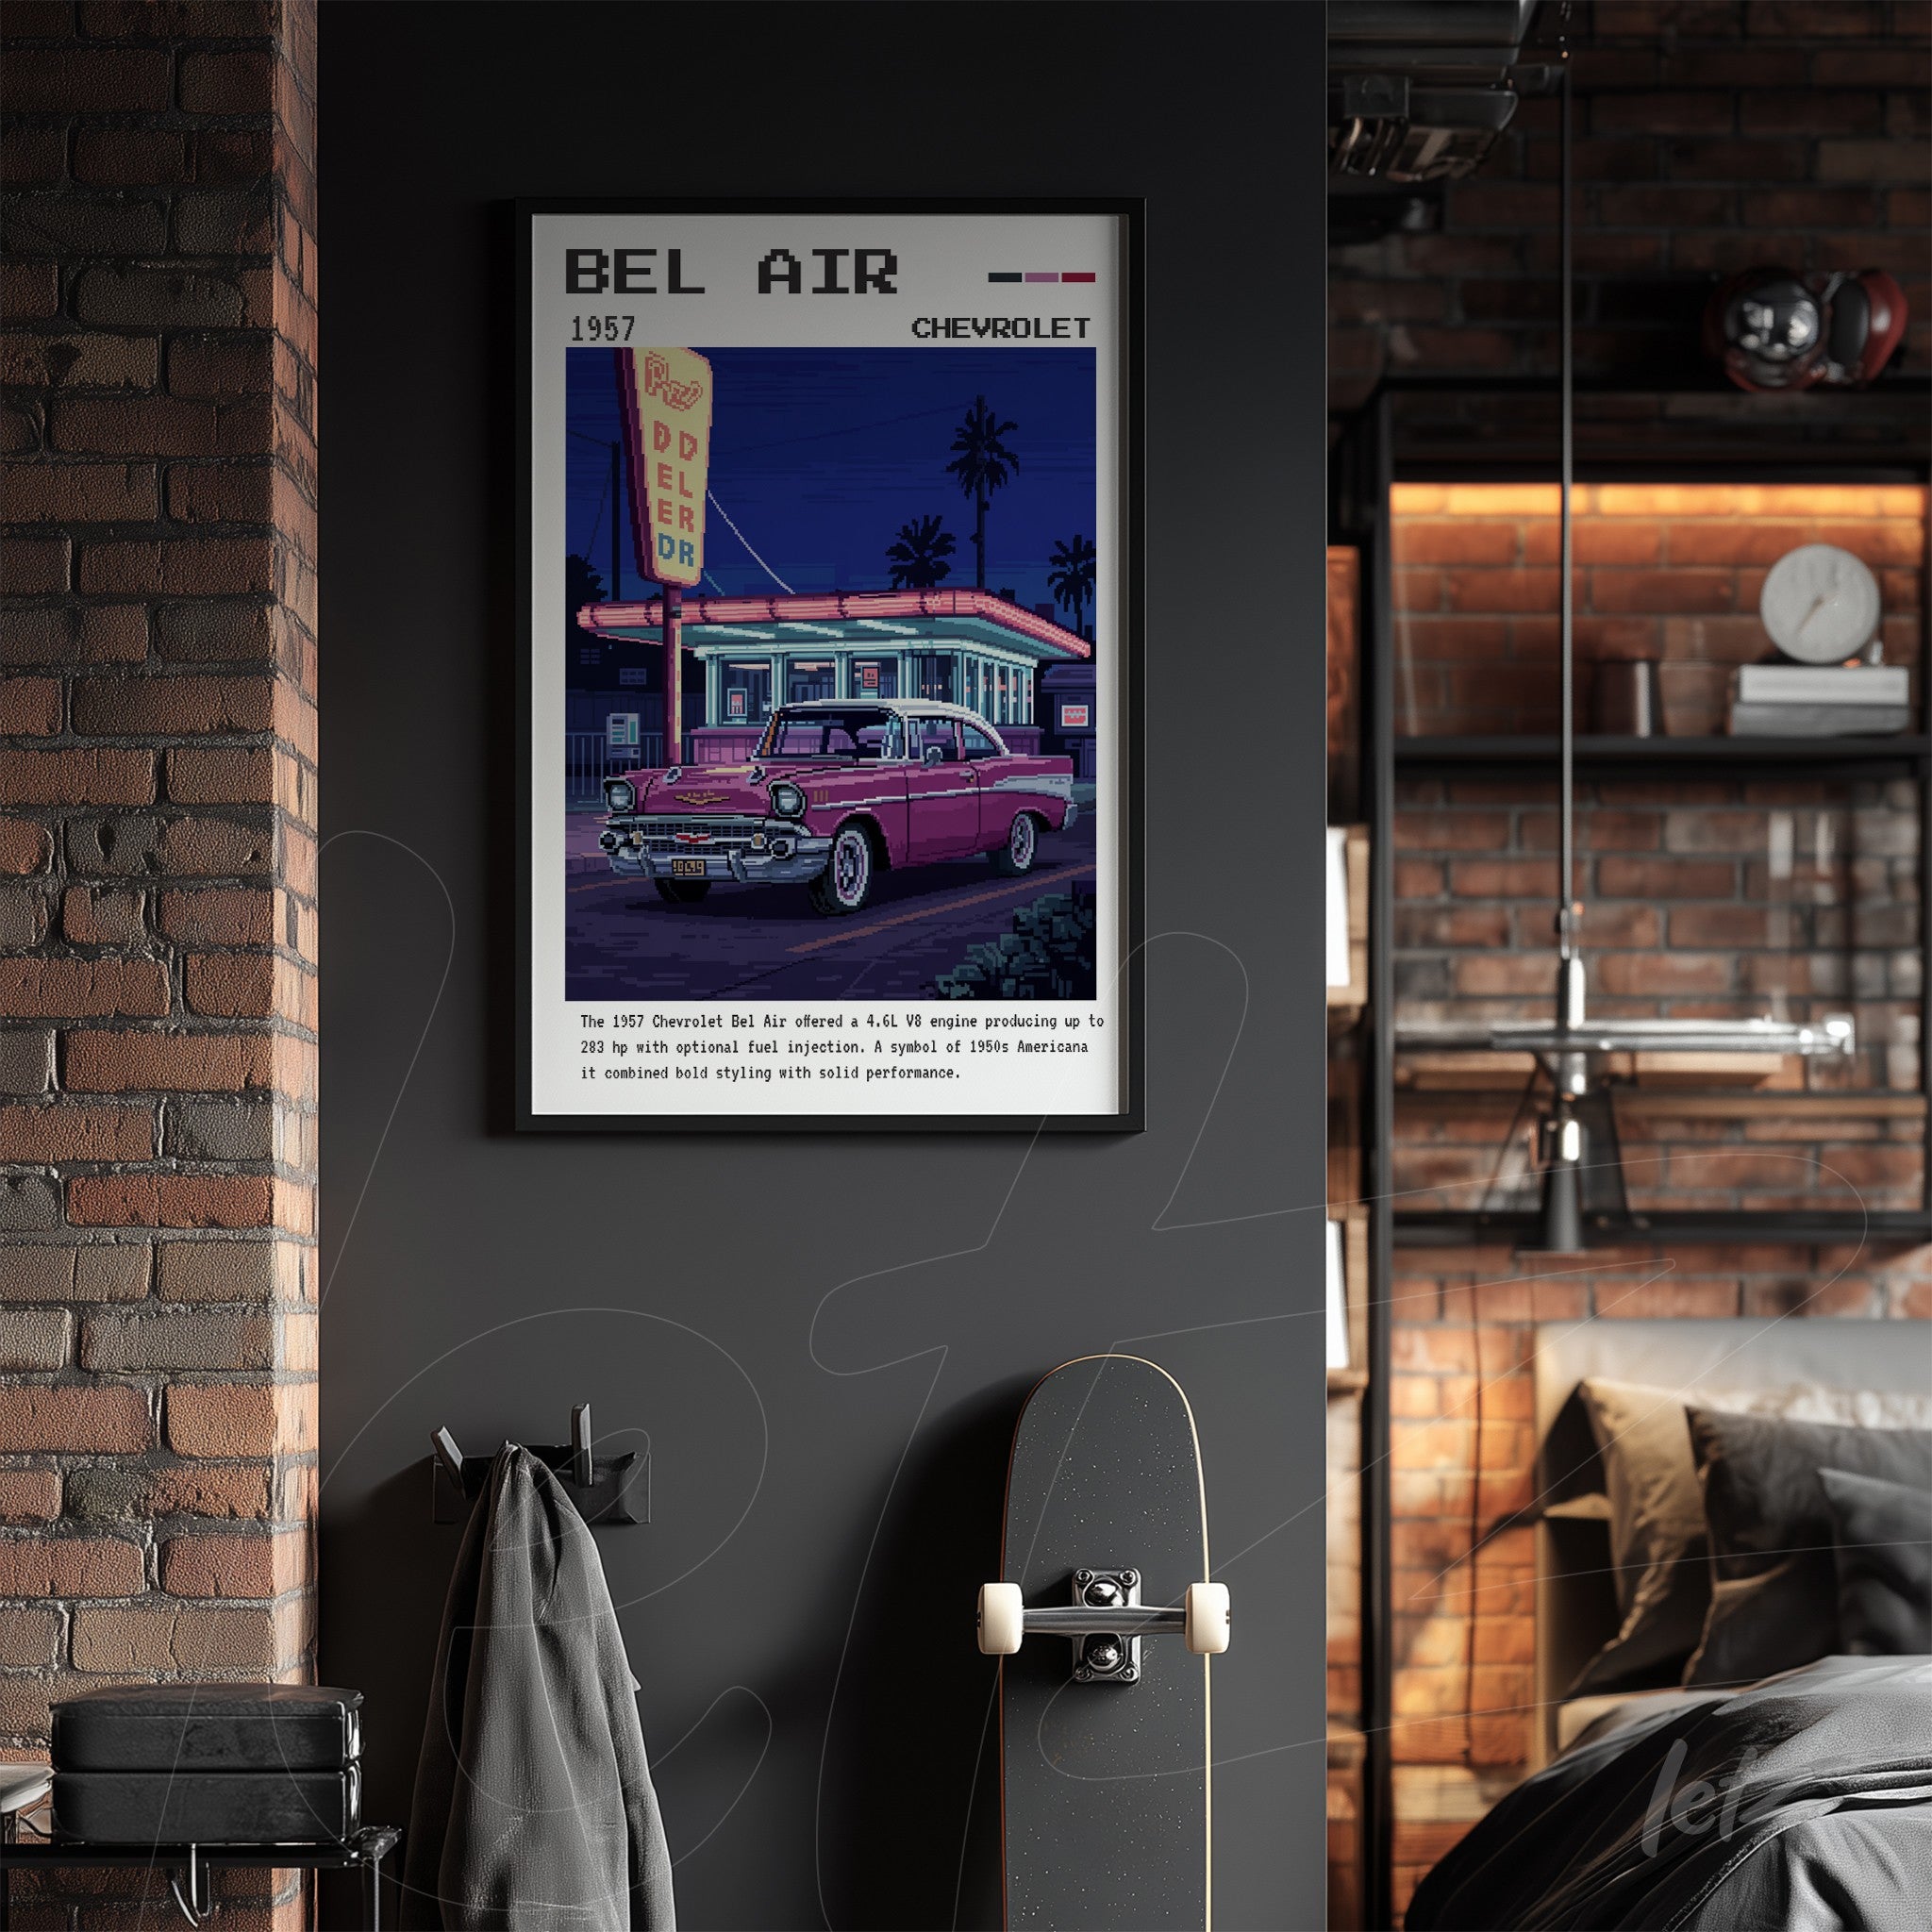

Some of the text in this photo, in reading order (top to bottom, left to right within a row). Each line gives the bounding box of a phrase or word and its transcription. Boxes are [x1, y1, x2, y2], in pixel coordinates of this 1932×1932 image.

[565, 248, 898, 294] BEL AIR
[571, 315, 636, 341] 1957
[911, 317, 1091, 339] CHEVROLET
[580, 1013, 1105, 1030] The 1957 Chevrolet Bel Air offered a 4.6L V8 engine producing up to
[580, 1040, 1089, 1058] 283 hp with optional fuel injection. A symbol of 1950s Americana
[581, 1065, 960, 1083] it combined bold styling with solid performance.
